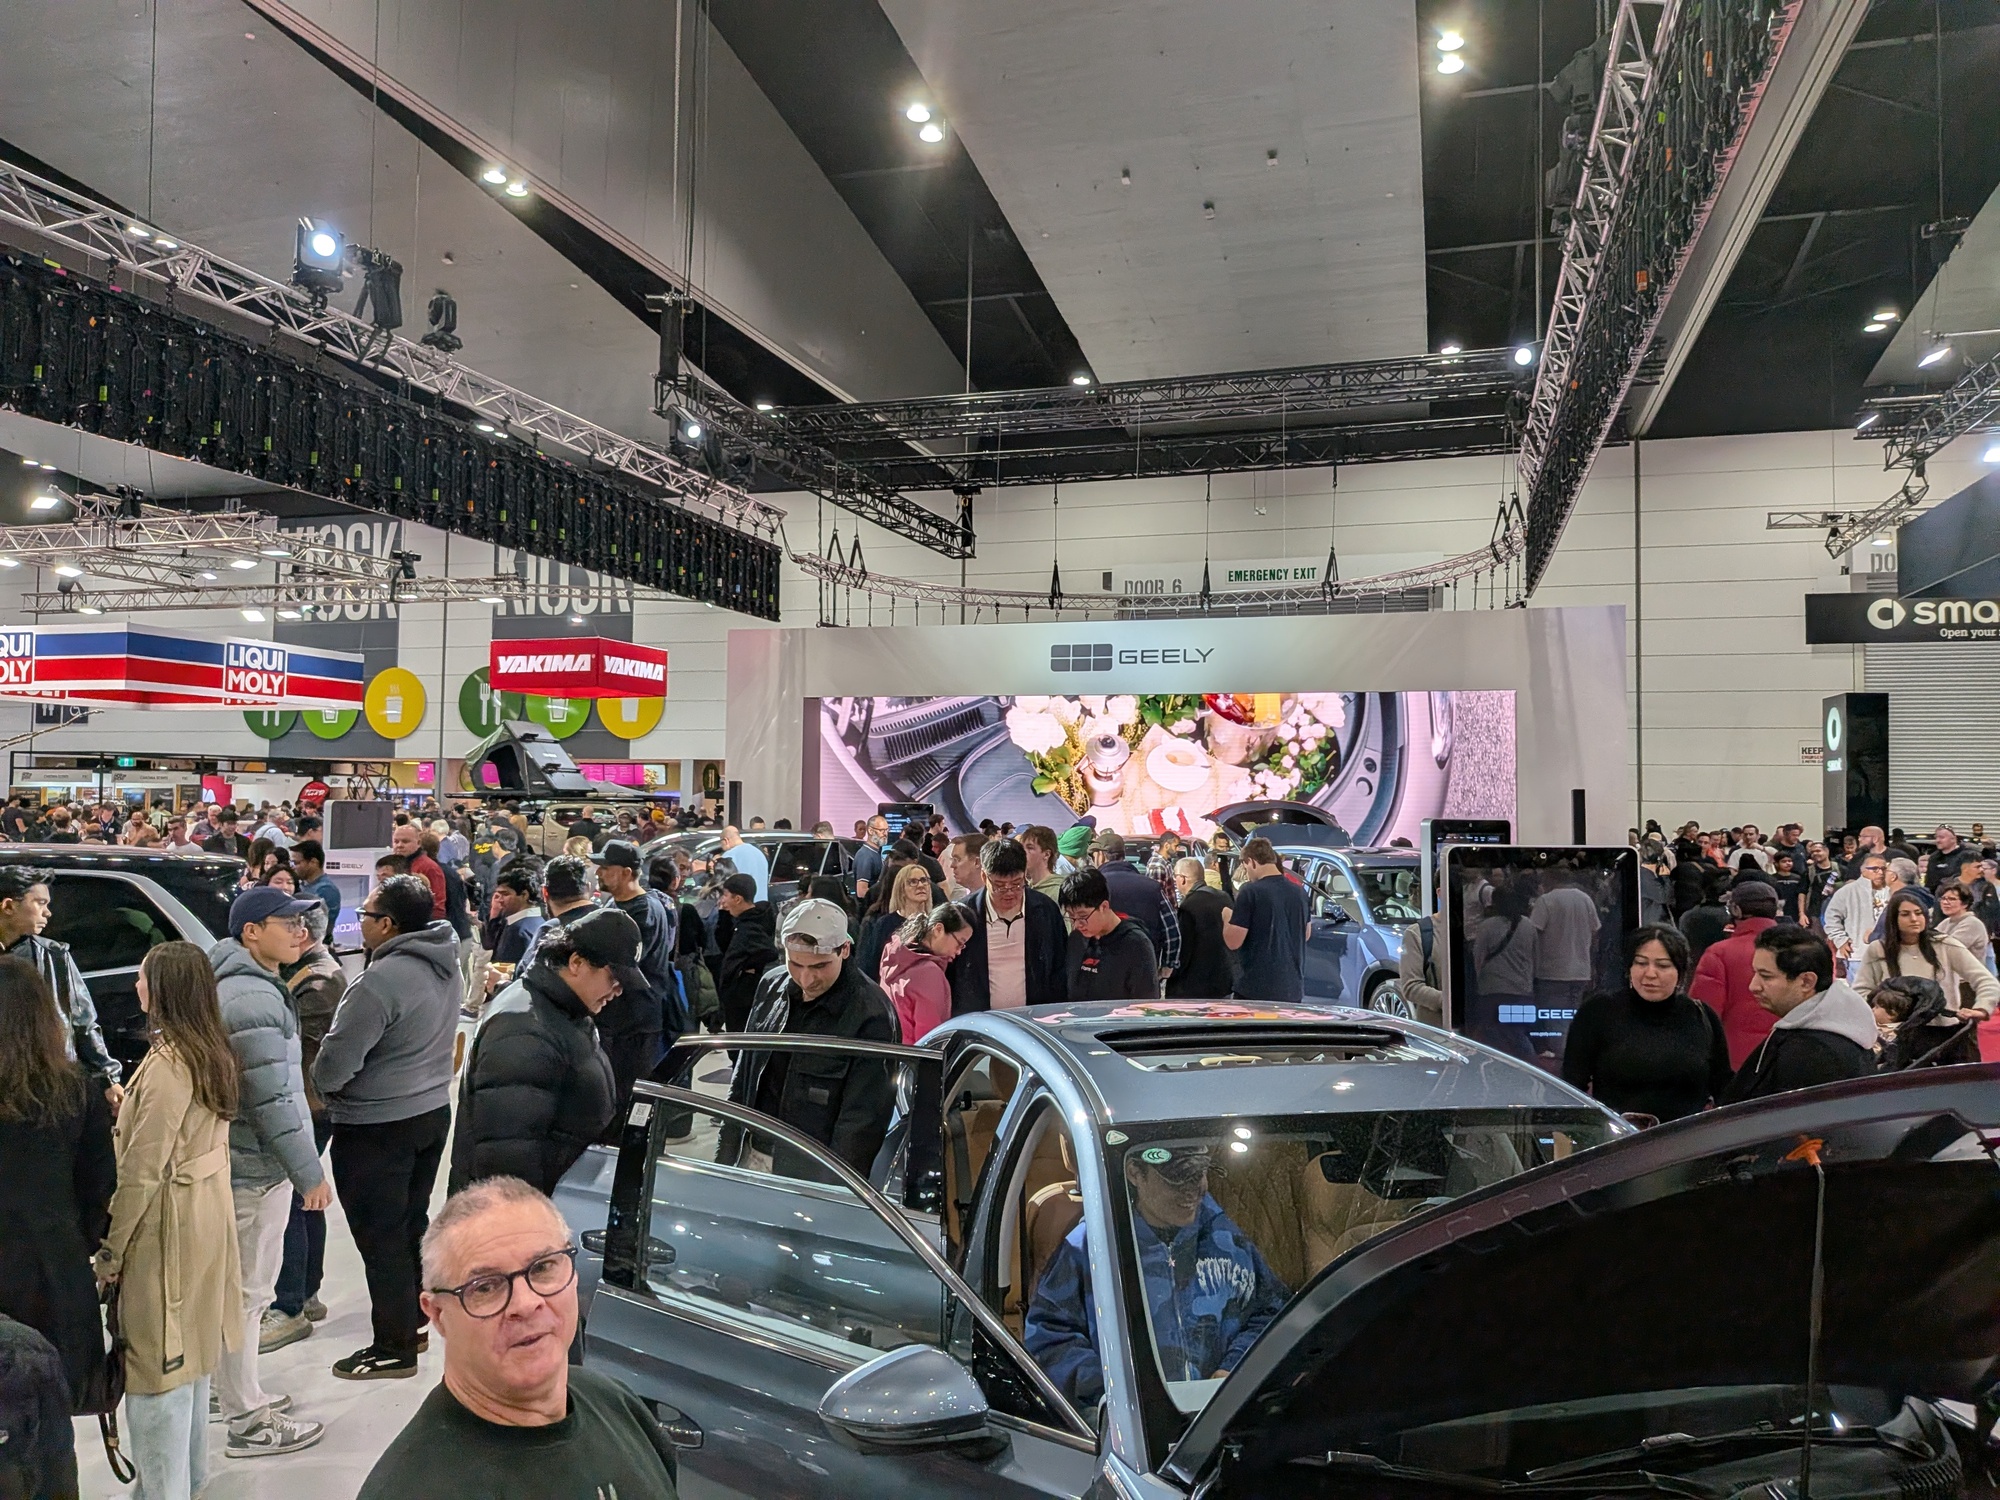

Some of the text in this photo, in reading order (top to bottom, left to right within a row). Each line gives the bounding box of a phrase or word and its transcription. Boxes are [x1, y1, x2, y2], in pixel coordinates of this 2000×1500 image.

[1228, 566, 1317, 583] EMERGENCY EXIT
[1124, 578, 1182, 595] DOOR 6
[1912, 600, 2000, 625] sma
[1940, 628, 1997, 639] Open your
[228, 645, 284, 671] LIQUI
[497, 654, 592, 673] YAKIMA
[1118, 648, 1215, 664] GEELY
[603, 655, 664, 681] YAKIMA
[227, 669, 284, 695] MOLY
[1801, 747, 1823, 755] KEEP
